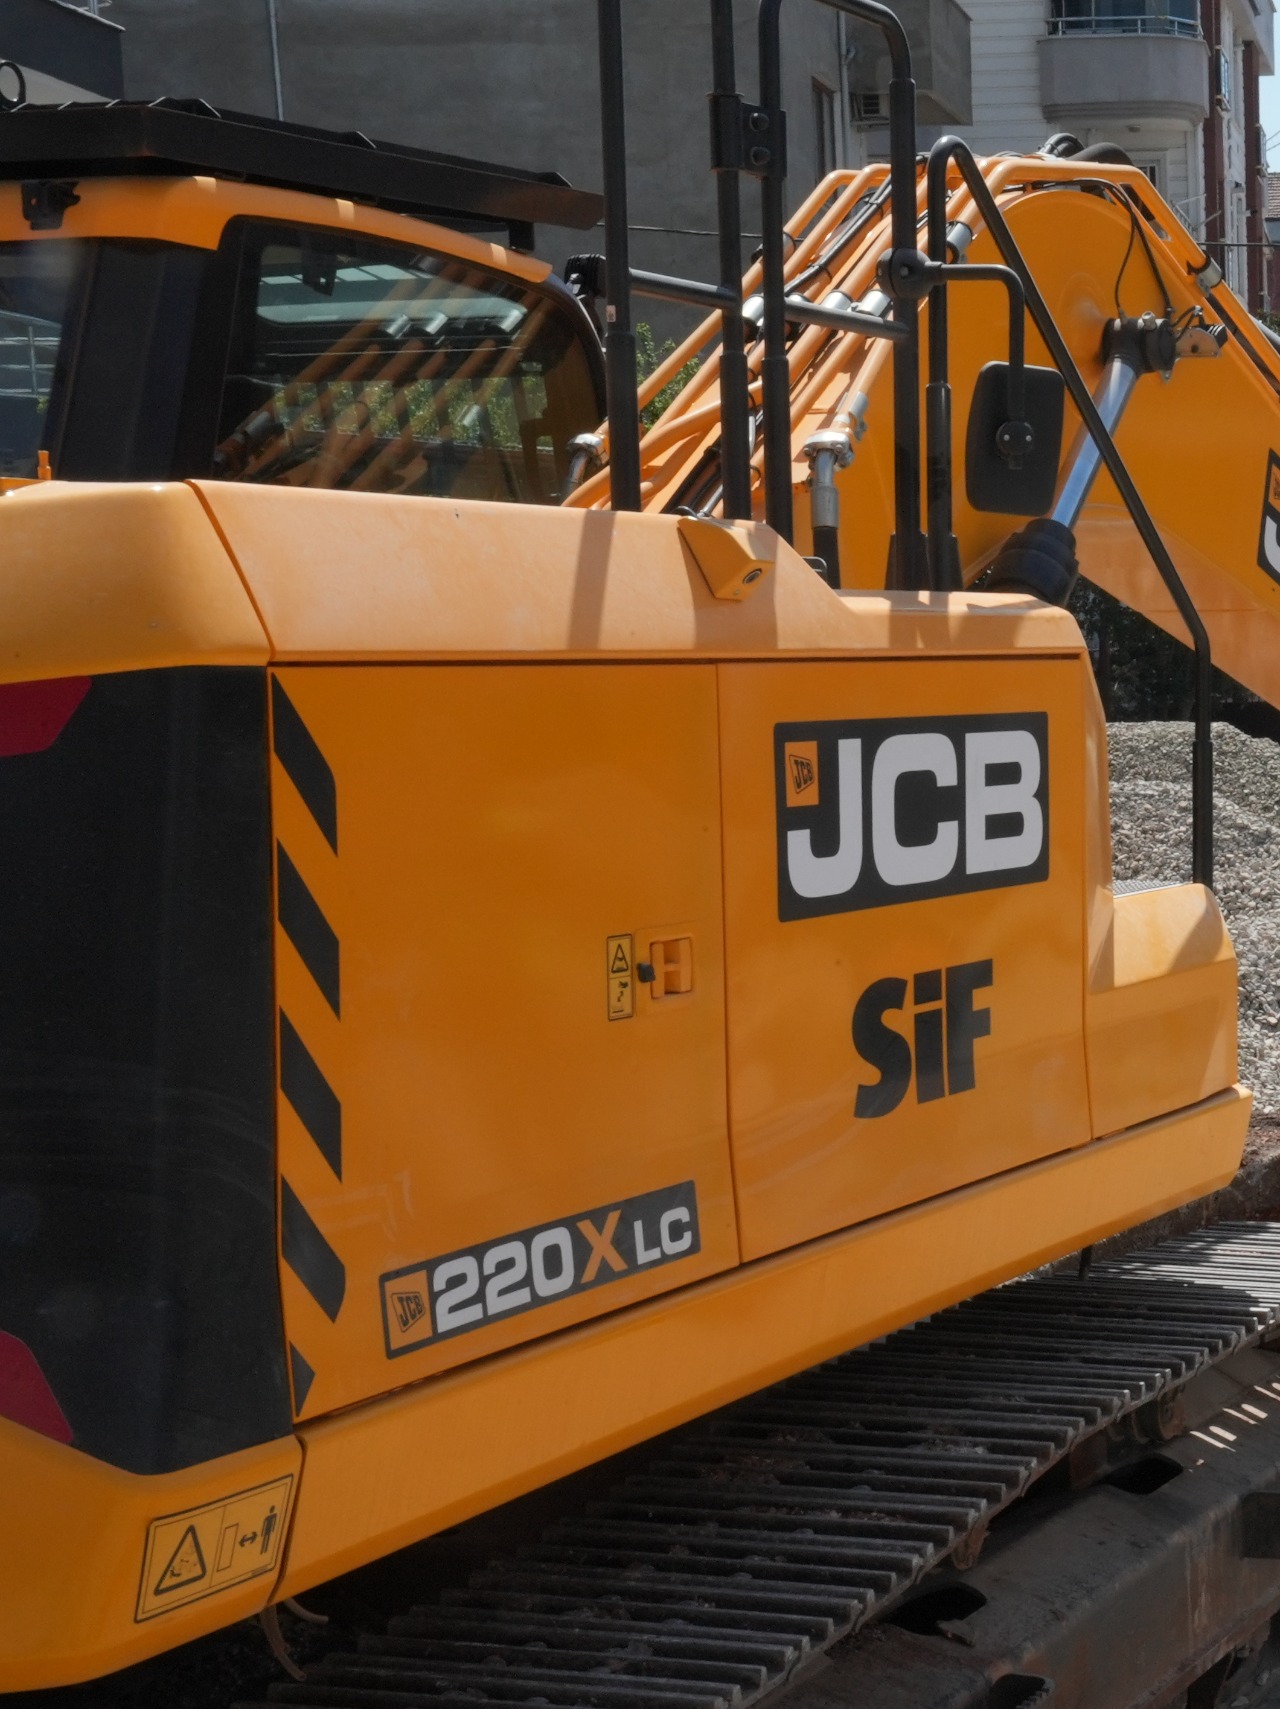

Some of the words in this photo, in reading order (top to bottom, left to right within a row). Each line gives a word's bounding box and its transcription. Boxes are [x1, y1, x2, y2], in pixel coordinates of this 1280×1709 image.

[793, 758, 815, 792] JCB
[787, 730, 1044, 898] JCB
[397, 1296, 425, 1327] JCB
